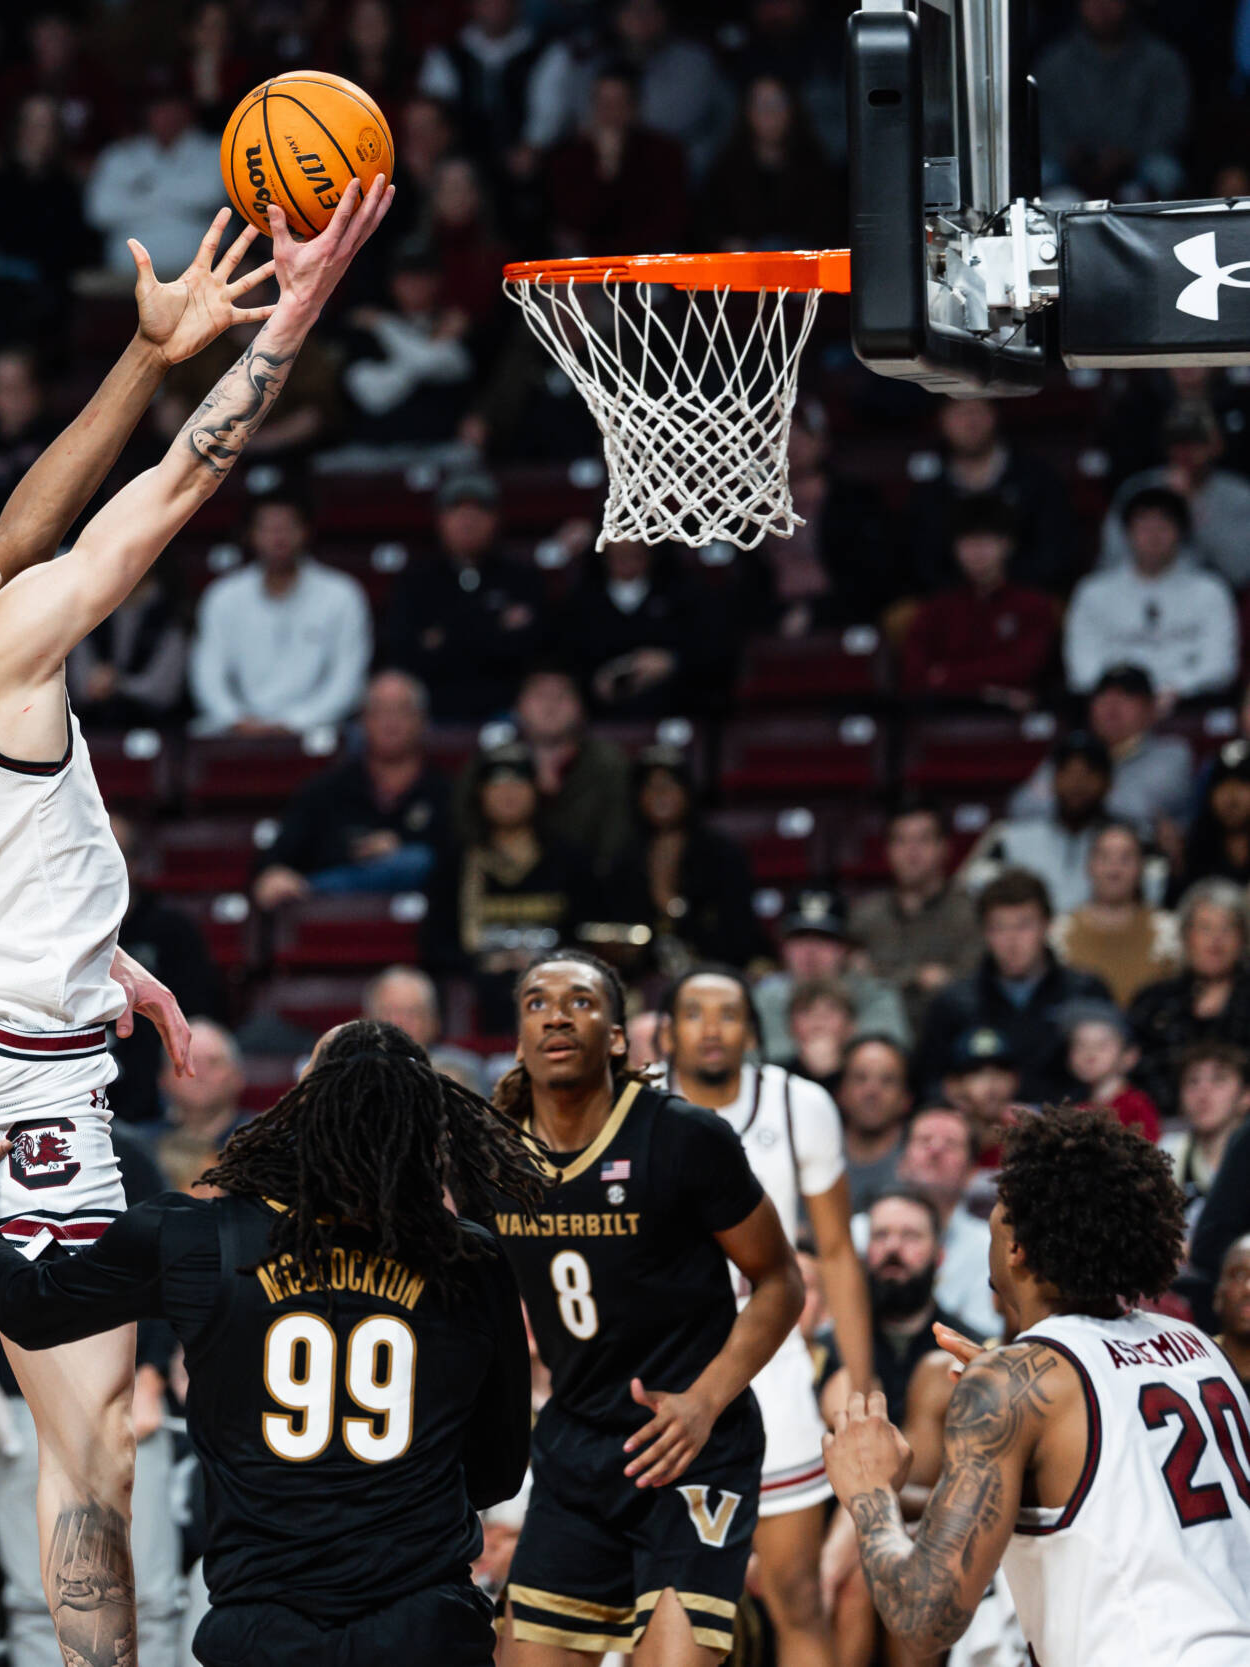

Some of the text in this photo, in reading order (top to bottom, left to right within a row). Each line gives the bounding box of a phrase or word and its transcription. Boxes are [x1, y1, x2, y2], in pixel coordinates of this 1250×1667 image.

[495, 1212, 641, 1237] VANDERBILT
[551, 1249, 600, 1342] 8
[261, 1311, 418, 1465] 99
[1137, 1376, 1250, 1529] 20
[675, 1484, 743, 1549] V
